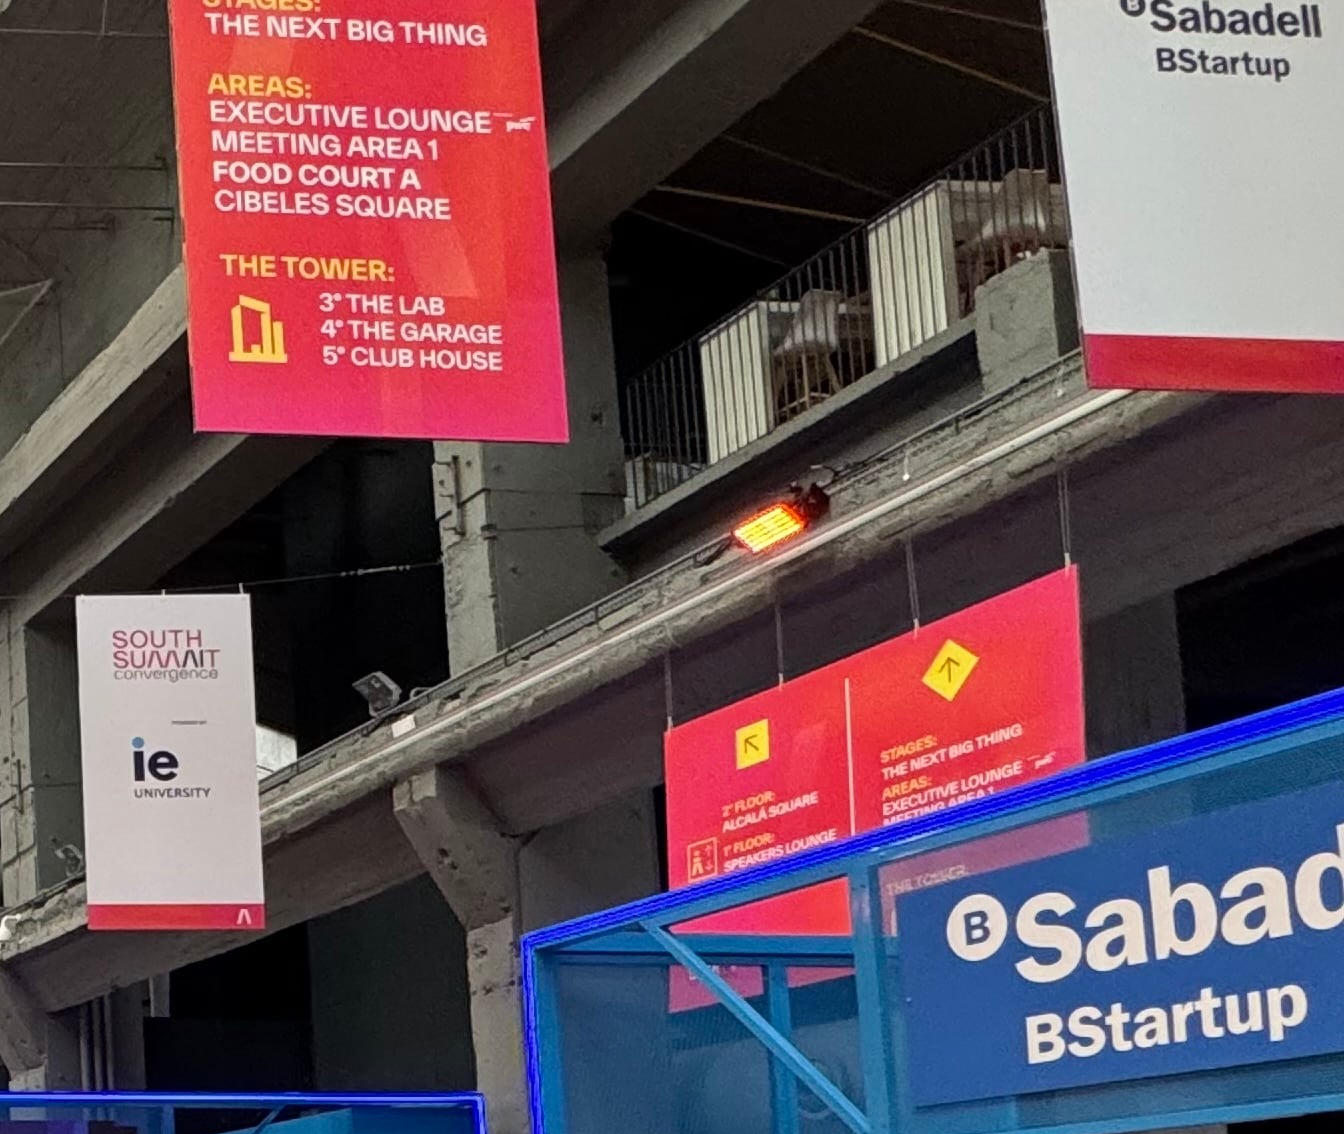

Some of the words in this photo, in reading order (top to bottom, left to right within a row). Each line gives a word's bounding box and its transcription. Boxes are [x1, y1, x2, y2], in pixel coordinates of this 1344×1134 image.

[204, 13, 260, 36] THE
[267, 16, 341, 40] NEXT
[347, 20, 394, 42] BIG
[399, 22, 487, 46] THING
[1150, 0, 1322, 38] Sabadell
[1156, 47, 1290, 82] BStartup
[208, 73, 312, 98] AREAS:
[210, 101, 368, 128] EXECUTIVE
[375, 107, 491, 134] LOUNGE
[212, 131, 341, 156] MEETING
[347, 137, 423, 159] AREA
[428, 139, 439, 160] 1
[213, 161, 292, 185] FOOD
[298, 165, 395, 188] COURT
[400, 168, 421, 190] A
[214, 189, 329, 215] CIBELES
[336, 194, 451, 220] SQUARE
[220, 254, 276, 278] THE
[282, 256, 395, 282] TOWER:
[345, 293, 393, 315] THE
[400, 296, 445, 316] LAB
[346, 320, 395, 342] THE
[400, 323, 503, 345] GARAGE
[351, 346, 414, 369] CLUB
[420, 350, 503, 371] HOUSE
[112, 629, 202, 649] SOUTH
[112, 649, 220, 669] SUMMIT
[113, 668, 218, 683] convergence
[131, 736, 179, 782] ie
[880, 734, 938, 764] STAGES:
[881, 761, 909, 780] THE
[910, 748, 948, 772] NEXT
[949, 740, 974, 760] BIG
[975, 723, 1023, 749] THING
[134, 787, 211, 799] UNIVERSITY
[734, 790, 775, 814] FLOOR:
[882, 775, 933, 800] AREAS:
[882, 781, 959, 816] EXECUTIVE
[961, 760, 1023, 791] LOUNGE
[768, 791, 819, 818] SQUARE
[723, 844, 785, 873] SPEAKERS
[785, 828, 838, 855] LOUNGE
[1025, 985, 1308, 1065] BStartup
